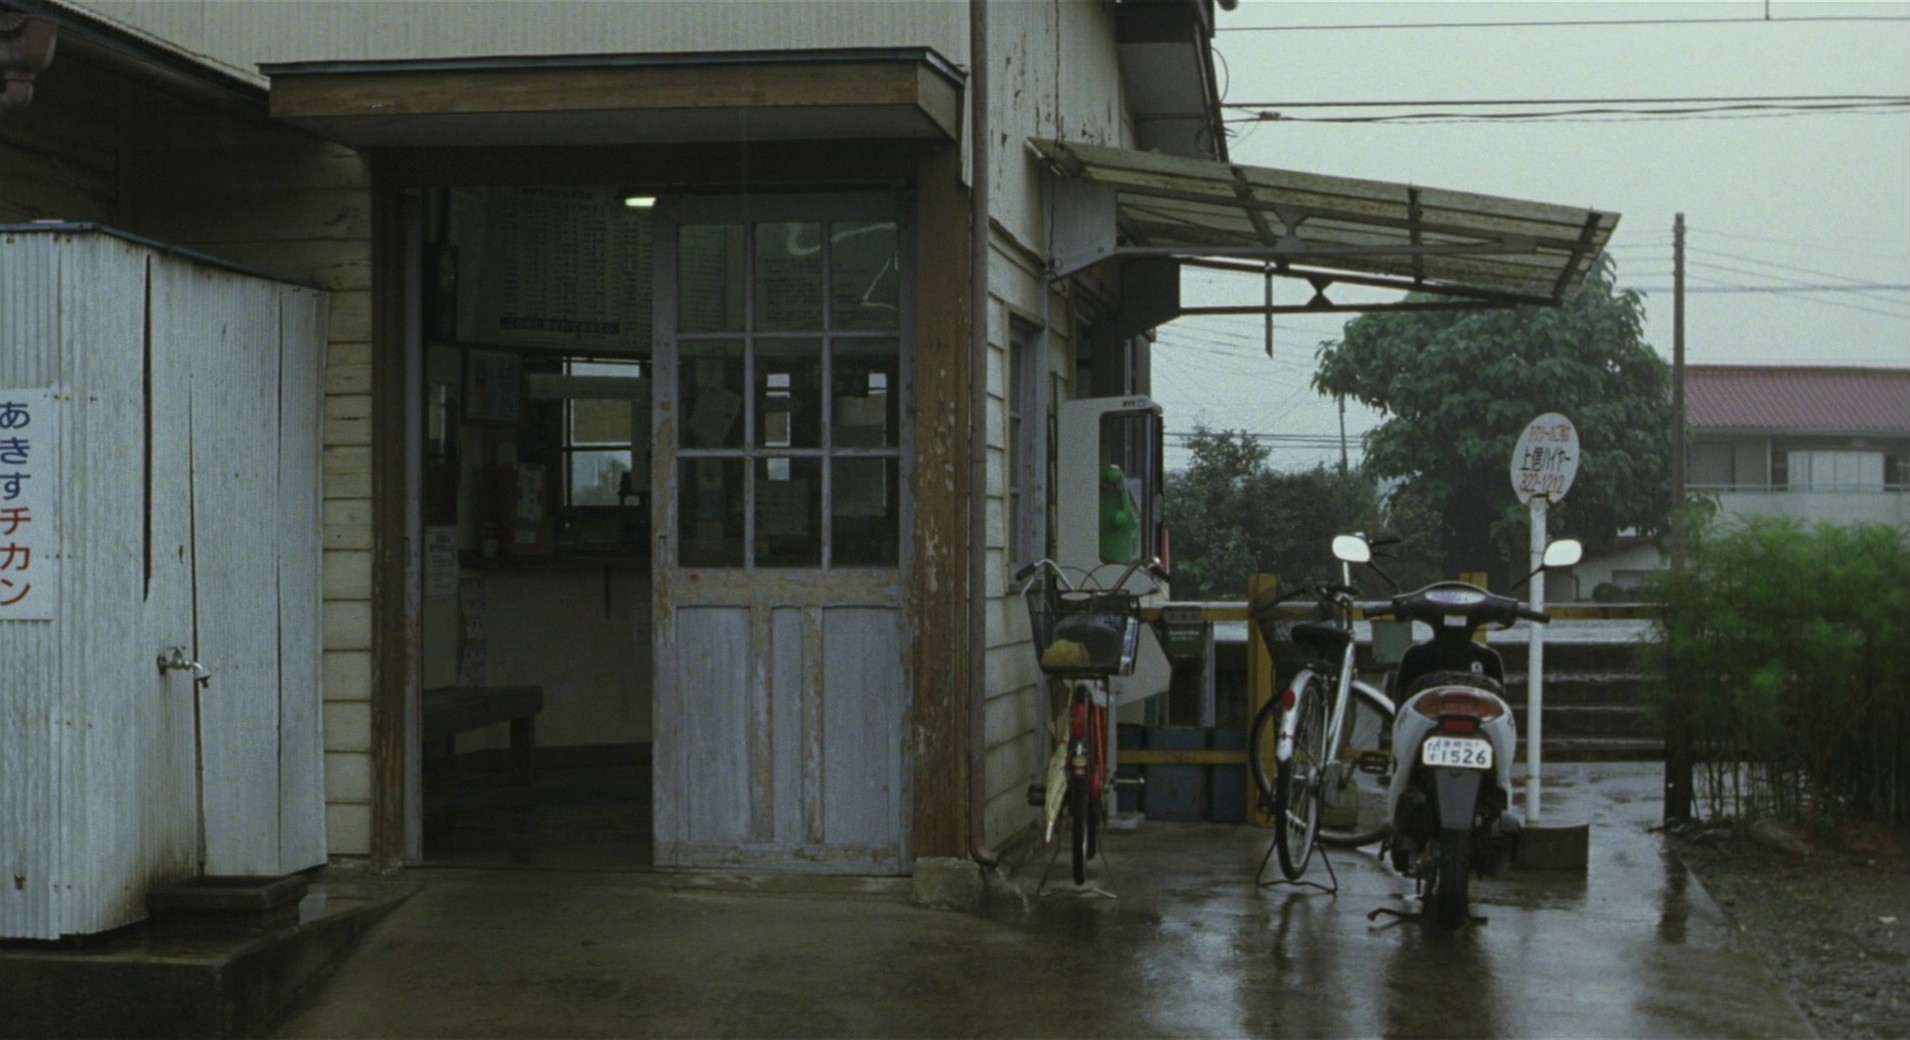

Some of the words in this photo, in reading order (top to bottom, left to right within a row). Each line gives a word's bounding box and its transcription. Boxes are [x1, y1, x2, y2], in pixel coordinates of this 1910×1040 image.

[0, 401, 31, 606] あきすチカン
[1441, 748, 1487, 765] 1526
